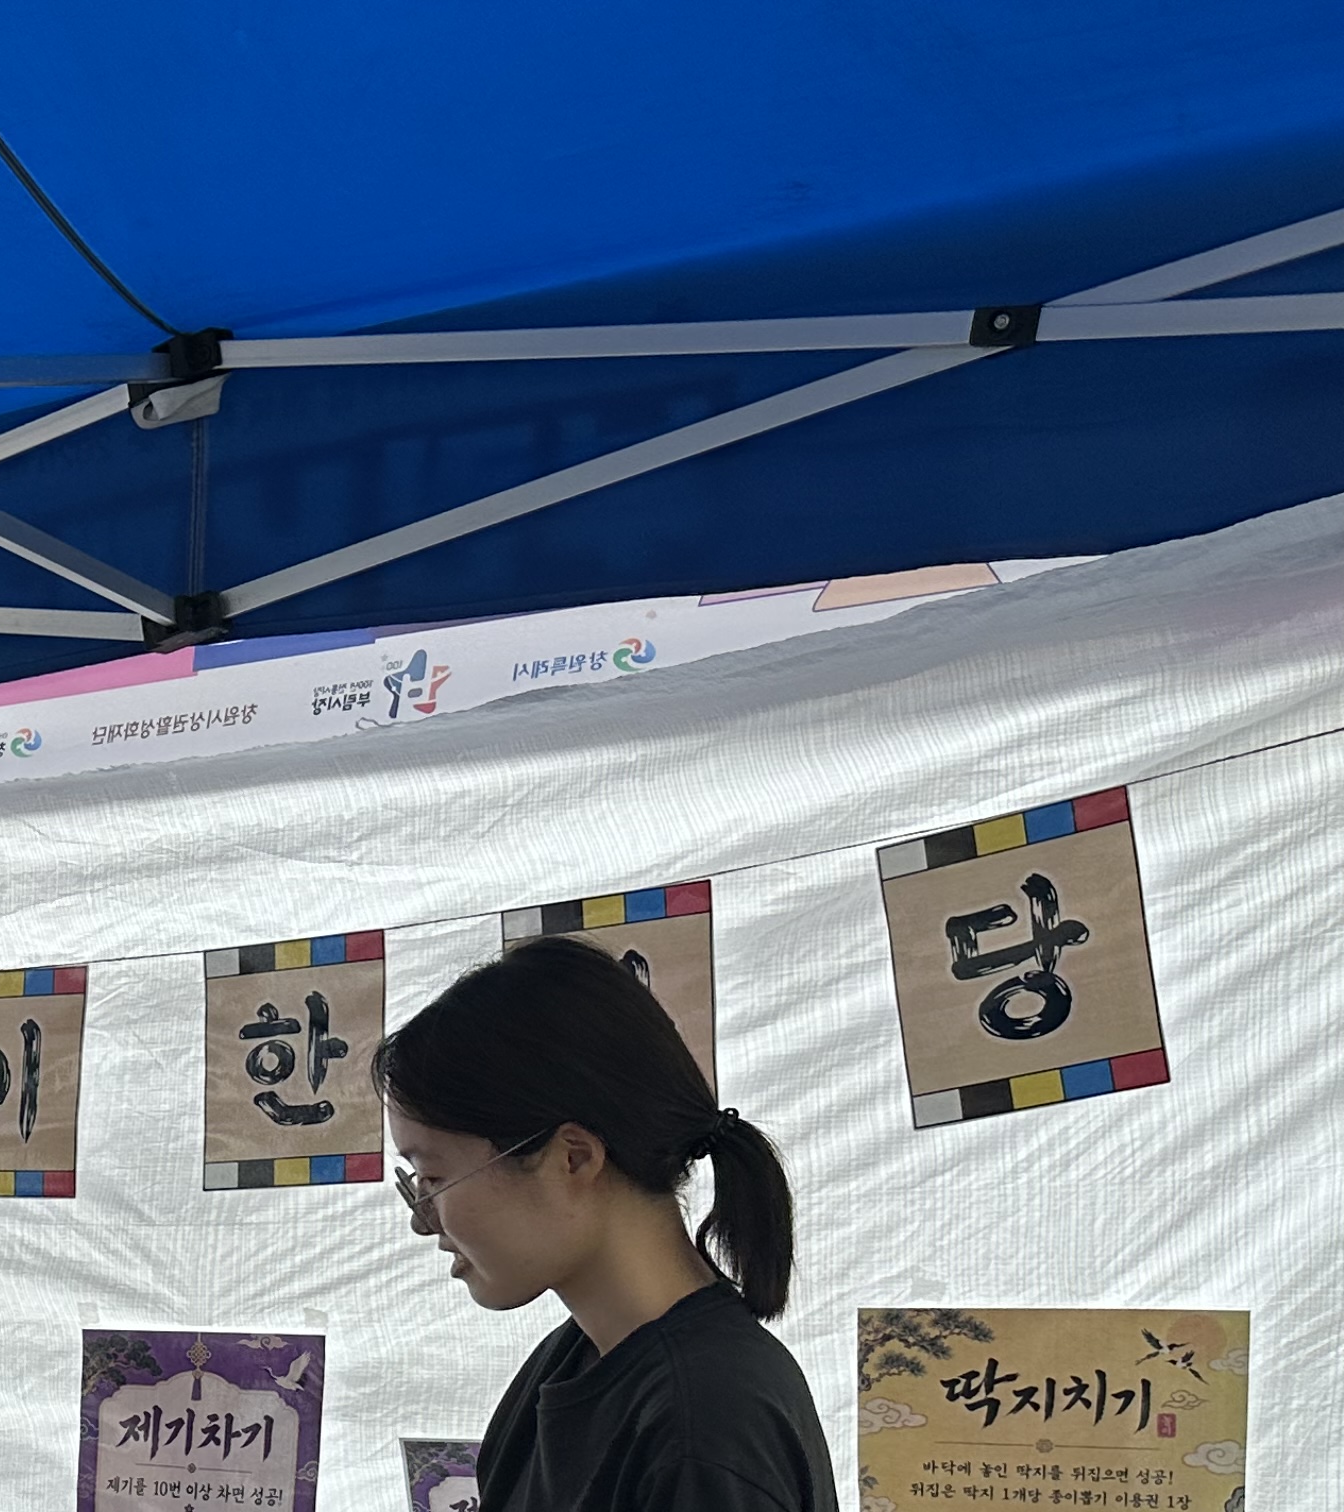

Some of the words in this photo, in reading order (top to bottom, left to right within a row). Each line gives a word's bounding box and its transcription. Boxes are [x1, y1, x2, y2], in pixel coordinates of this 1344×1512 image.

[238, 990, 350, 1127] 한
[946, 872, 1092, 1040] 당
[940, 1357, 1151, 1434] 딱지치기
[115, 1405, 274, 1462] 제기차기
[106, 1475, 148, 1495] 제기를
[153, 1480, 181, 1499] 10번
[186, 1482, 212, 1501] 이상
[216, 1484, 245, 1504] 차면
[250, 1487, 283, 1507] 성공!
[923, 1460, 972, 1476] 바닥에
[979, 1461, 1007, 1479] 놓인
[1016, 1463, 1063, 1481] 딱지를
[1070, 1465, 1129, 1483] 뒤집으면
[1135, 1468, 1174, 1486] 성공!
[909, 1481, 956, 1499] 뒤집은
[963, 1484, 994, 1500] 딱지
[1002, 1486, 1042, 1503] 1개당
[1048, 1488, 1108, 1507] 종이뽑기
[1115, 1491, 1160, 1509] 이용권
[1167, 1494, 1193, 1512] 1장
